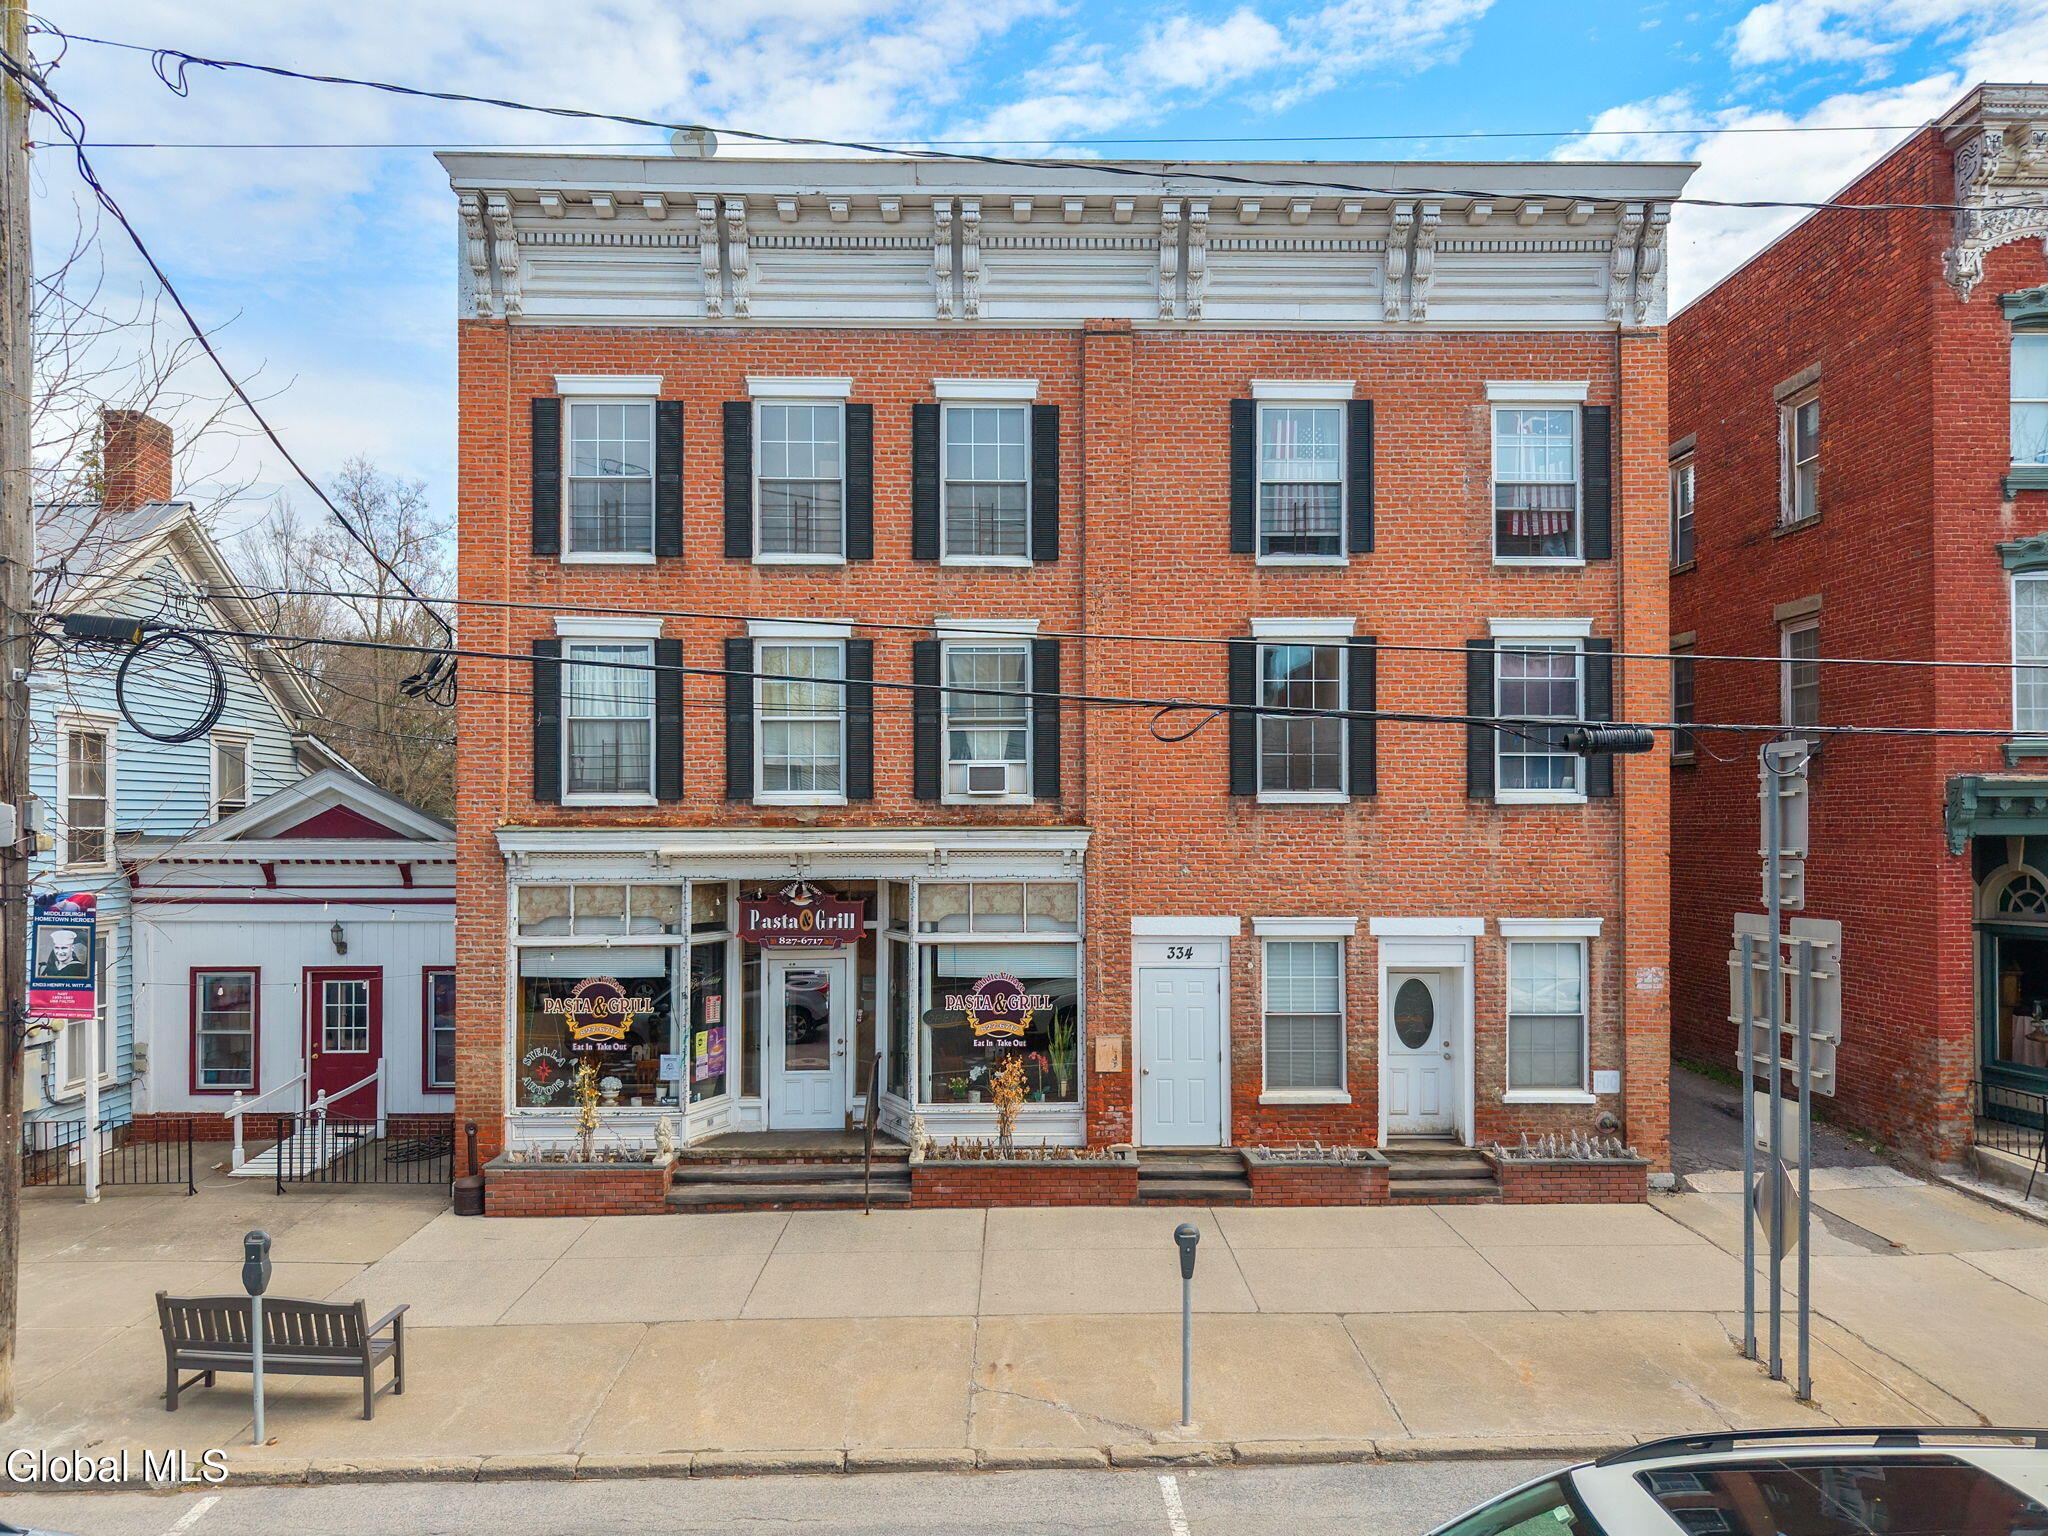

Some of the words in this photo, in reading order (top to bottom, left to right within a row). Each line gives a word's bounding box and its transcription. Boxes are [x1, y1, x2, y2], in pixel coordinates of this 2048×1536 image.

[750, 909, 798, 930] Pasta
[815, 909, 855, 930] Grill
[779, 937, 823, 945] 827-6717
[1167, 946, 1193, 960] 334
[544, 998, 592, 1013] PASTA
[592, 995, 608, 1018] &
[608, 998, 654, 1013] GRILL
[945, 994, 993, 1010] PASTA
[993, 992, 1008, 1014] &
[1007, 994, 1053, 1010] GRILL
[572, 1043, 584, 1051] Eat
[585, 1043, 593, 1051] In
[597, 1043, 612, 1051] Take
[613, 1043, 627, 1051] Out
[973, 1039, 985, 1047] Eat
[986, 1039, 993, 1047] In
[997, 1039, 1012, 1047] Take
[1013, 1039, 1026, 1047] Out
[523, 1046, 566, 1067] STELLA
[522, 1077, 565, 1095] ARTOIS
